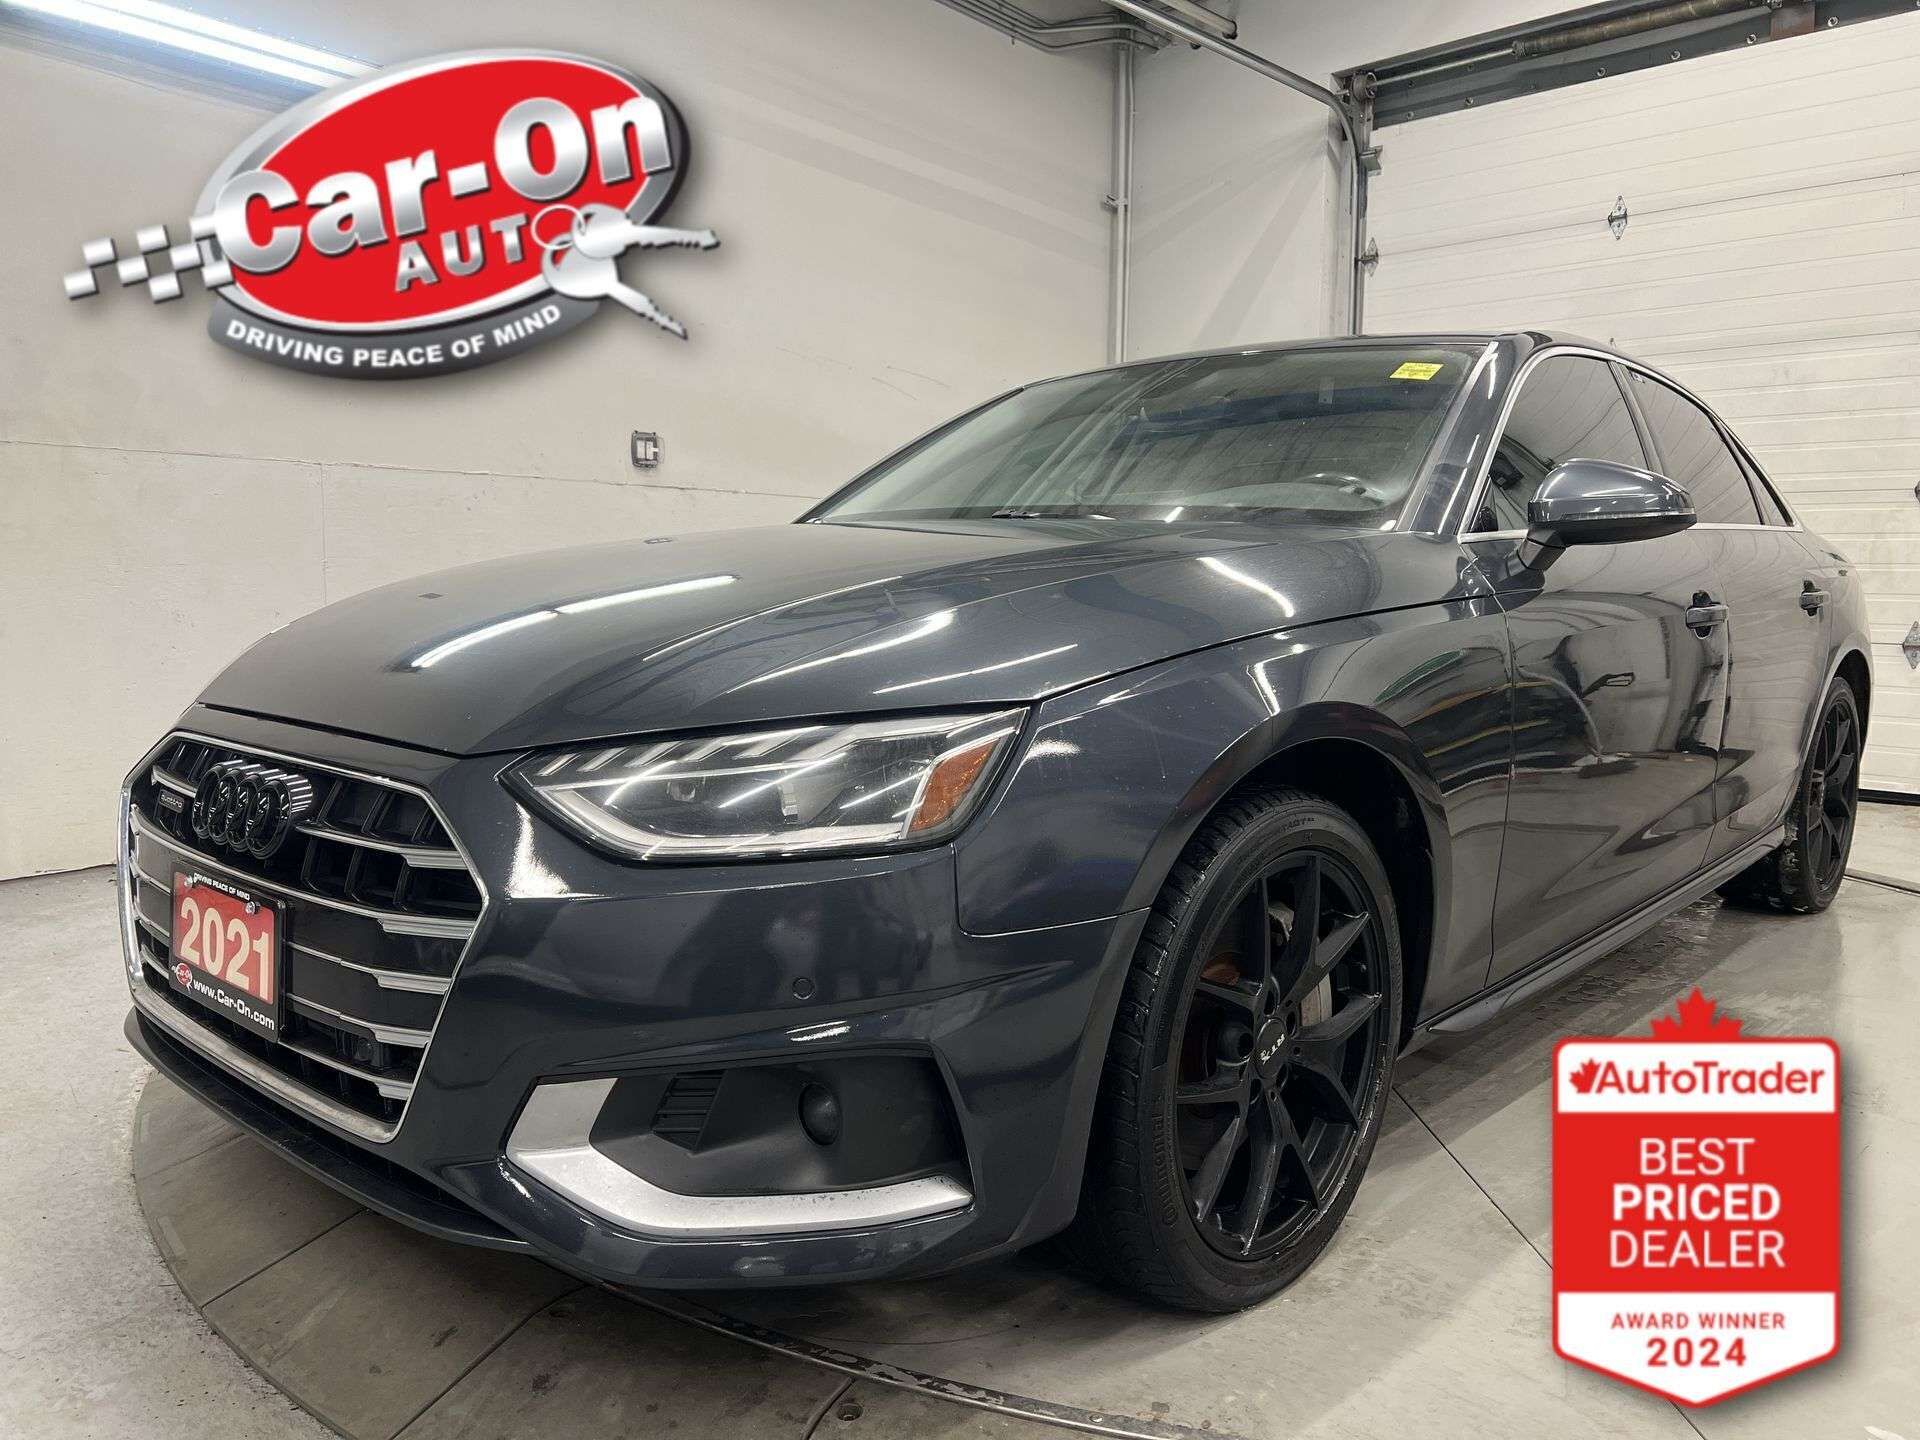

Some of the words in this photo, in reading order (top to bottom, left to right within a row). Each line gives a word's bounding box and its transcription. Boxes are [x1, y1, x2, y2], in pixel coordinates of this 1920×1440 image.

[212, 879, 229, 892] PEACE
[228, 886, 237, 895] OF
[180, 897, 269, 1000] 2021
[193, 979, 275, 1031] www.Car-On.com
